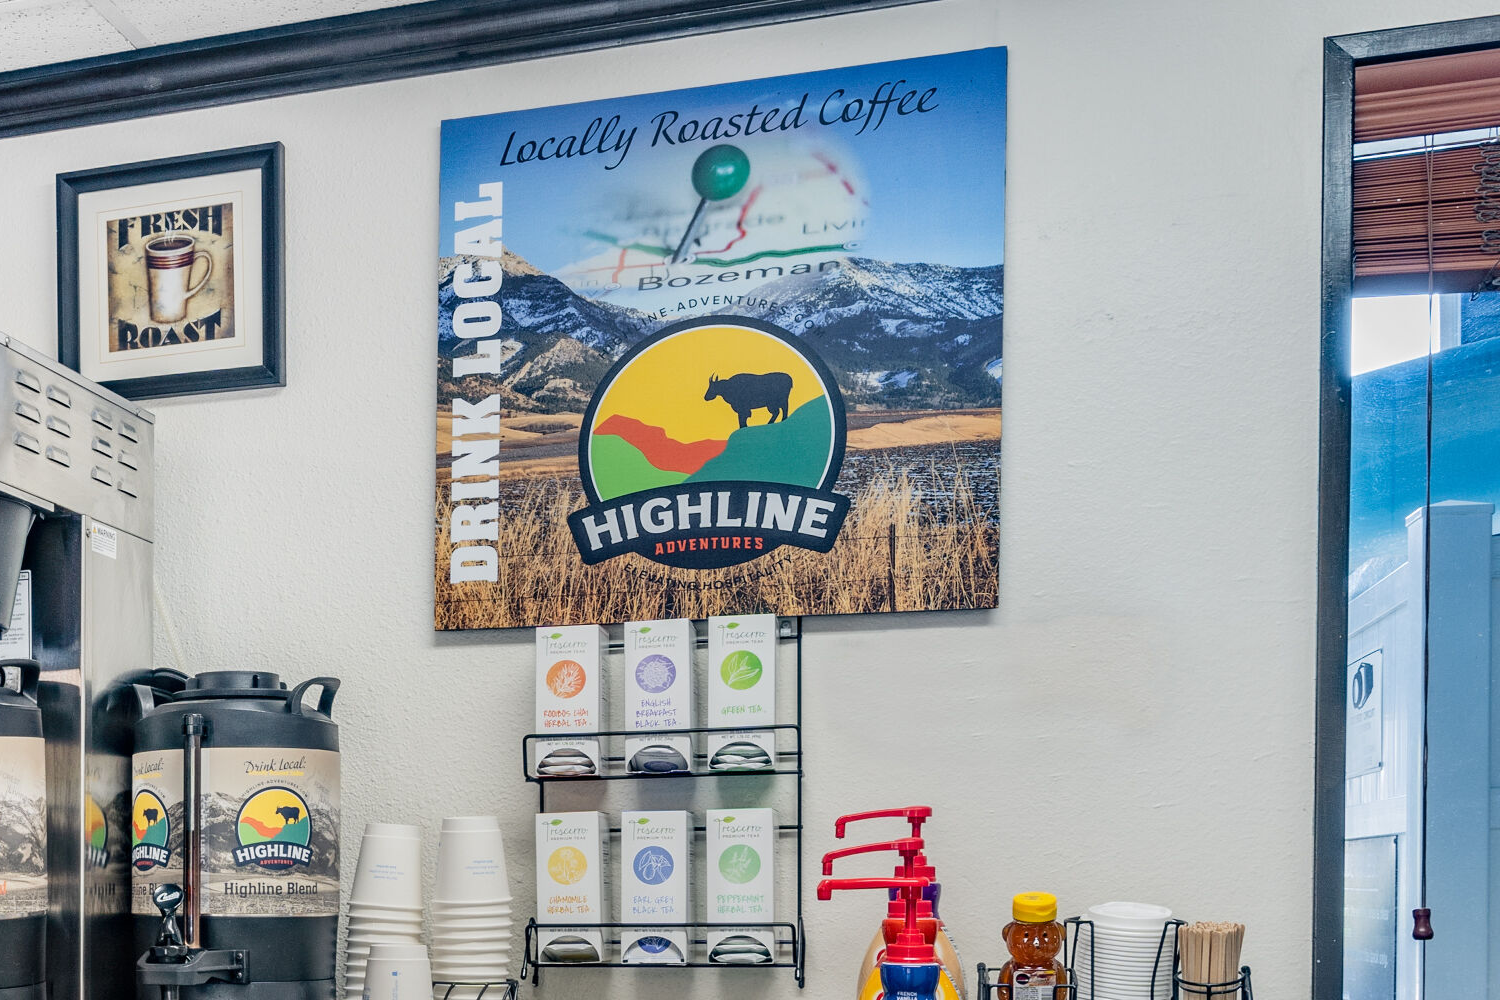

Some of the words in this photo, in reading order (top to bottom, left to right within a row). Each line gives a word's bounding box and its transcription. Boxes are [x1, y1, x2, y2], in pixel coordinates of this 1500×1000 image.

[500, 115, 636, 170] Locally
[651, 93, 810, 148] Roasted
[819, 79, 939, 136] Coffee
[118, 205, 222, 250] FRESH
[452, 182, 503, 377] LOCAL
[638, 259, 841, 291] Bozeman
[118, 308, 222, 350] ROAST
[450, 395, 501, 585] DRINK
[582, 491, 837, 551] HIGHLINE
[654, 536, 764, 556] ADVENTURES
[703, 554, 793, 591] HOSPITALITY
[641, 698, 671, 707] ENGLISH
[574, 709, 589, 717] CHAI
[635, 708, 677, 718] BREAKFAST
[720, 705, 746, 715] GREEN
[544, 719, 572, 728] HERBAL
[635, 719, 661, 728] BLACK
[244, 759, 277, 774] Drink
[238, 845, 311, 863] HIGHLINE
[224, 882, 283, 899] Highline
[287, 882, 318, 895] Blend
[548, 896, 587, 904] CHAMOMILE
[633, 895, 651, 904] EARL
[654, 896, 674, 904] GREY
[716, 894, 764, 904] PEPPERMINT
[547, 905, 574, 914] HERBAL
[632, 905, 658, 914] BLACK
[716, 904, 745, 914] HERBAL
